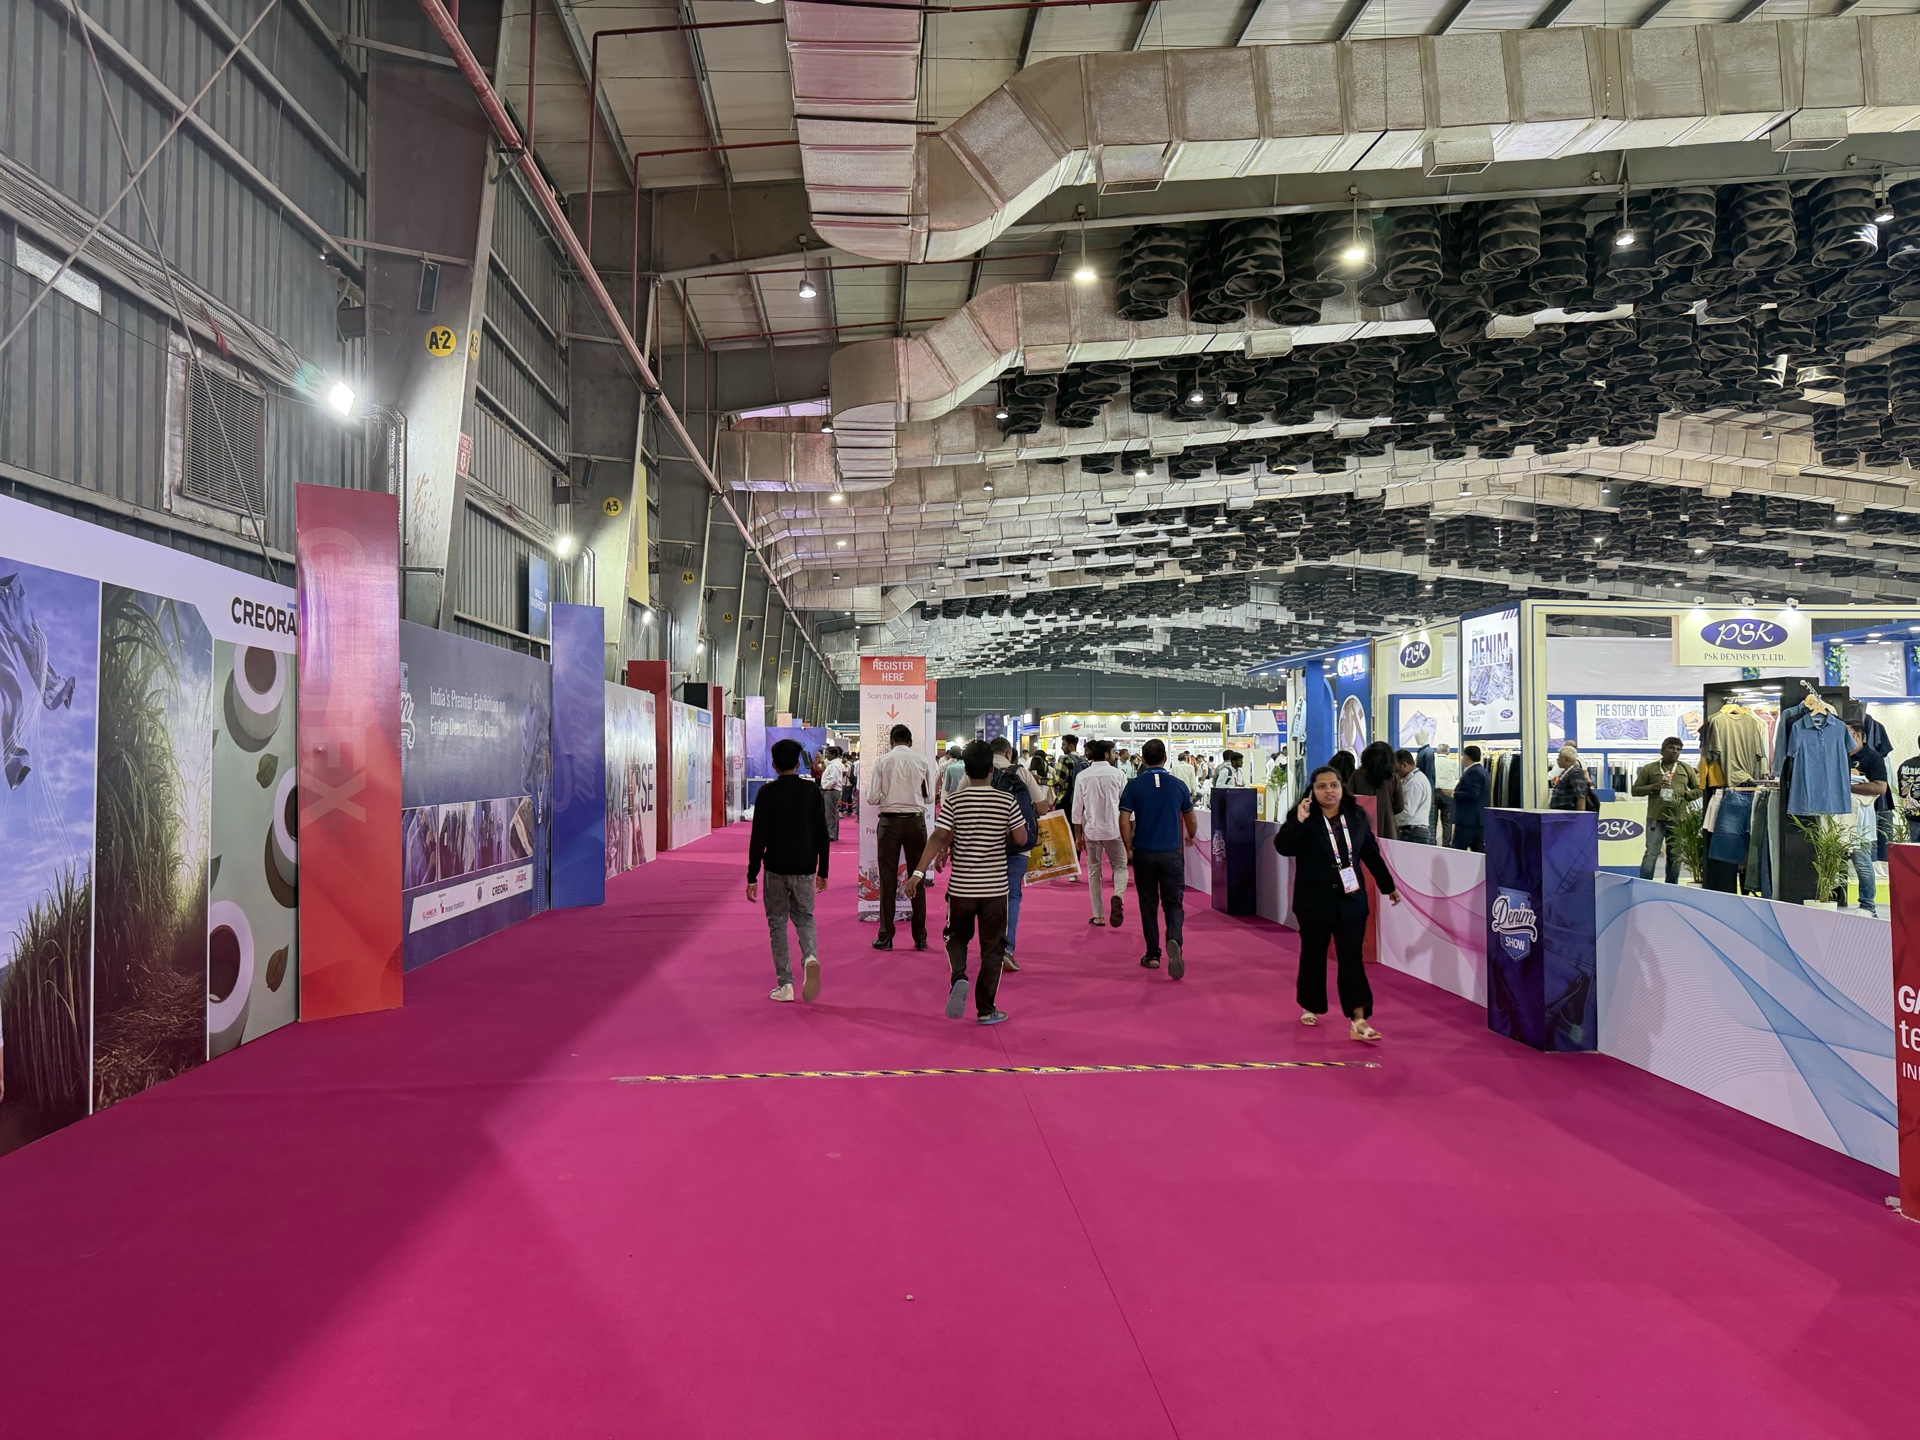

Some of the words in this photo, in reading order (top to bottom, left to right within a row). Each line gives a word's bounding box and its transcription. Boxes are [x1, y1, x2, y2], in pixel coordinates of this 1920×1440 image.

[429, 330, 452, 350] A-2
[231, 596, 297, 636] CREORA
[1715, 622, 1774, 646] PSK
[1404, 642, 1427, 667] PSK
[1471, 631, 1510, 668] DENIM
[1704, 652, 1719, 660] PSK
[1720, 652, 1750, 661] DENIMS
[1751, 653, 1768, 661] PVT.
[1769, 653, 1786, 662] LTD.
[872, 661, 914, 671] REGISTER
[881, 672, 905, 682] HERE
[430, 686, 451, 707] India's
[451, 689, 473, 710] Premier
[867, 692, 882, 700] Scan
[882, 692, 893, 700] this
[904, 692, 919, 700] Code
[1595, 704, 1610, 717] THE
[1611, 704, 1637, 717] STORY
[1639, 704, 1649, 717] OF
[430, 716, 449, 735] Entire
[1129, 723, 1167, 731] IMPRINT
[1171, 723, 1212, 731] OLUTION
[1491, 896, 1537, 934] Denim
[1505, 936, 1525, 951] SHOW
